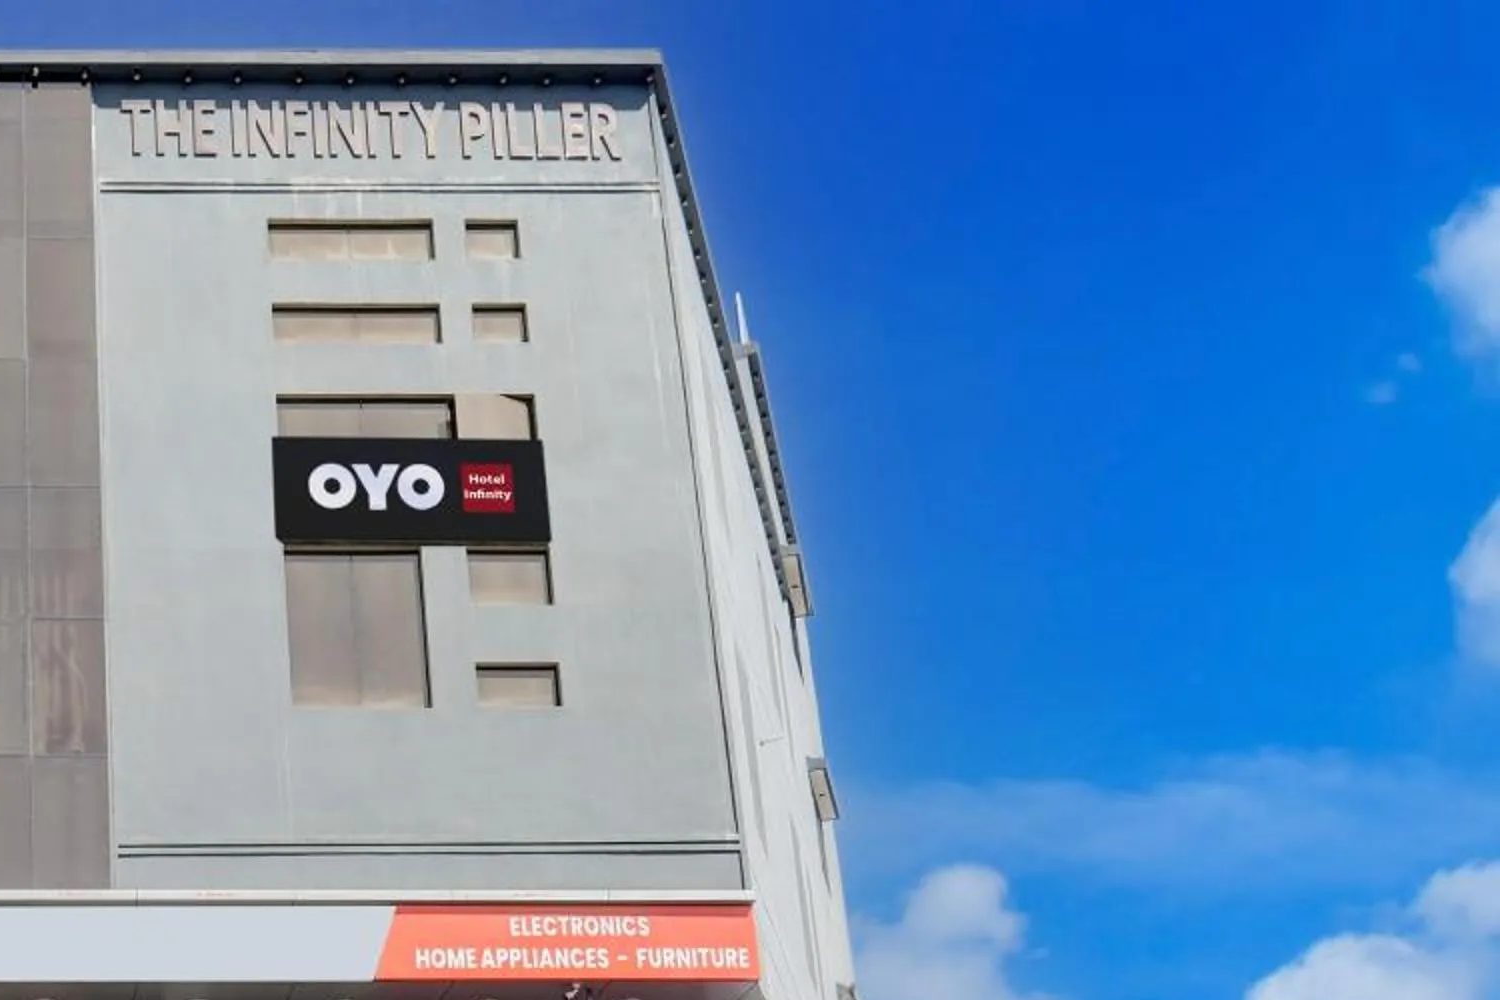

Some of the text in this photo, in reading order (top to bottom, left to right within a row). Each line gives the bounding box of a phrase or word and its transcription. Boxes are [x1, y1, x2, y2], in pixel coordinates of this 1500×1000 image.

[121, 99, 622, 162] THE INFINITY PILLER
[307, 463, 445, 511] OYO
[468, 473, 506, 487] Hotel
[463, 488, 513, 503] Infinity
[509, 915, 651, 937] ELECTRONICS
[415, 948, 477, 969] HOME
[481, 948, 610, 969] APPLIANCES
[635, 947, 750, 970] FURNITURE
